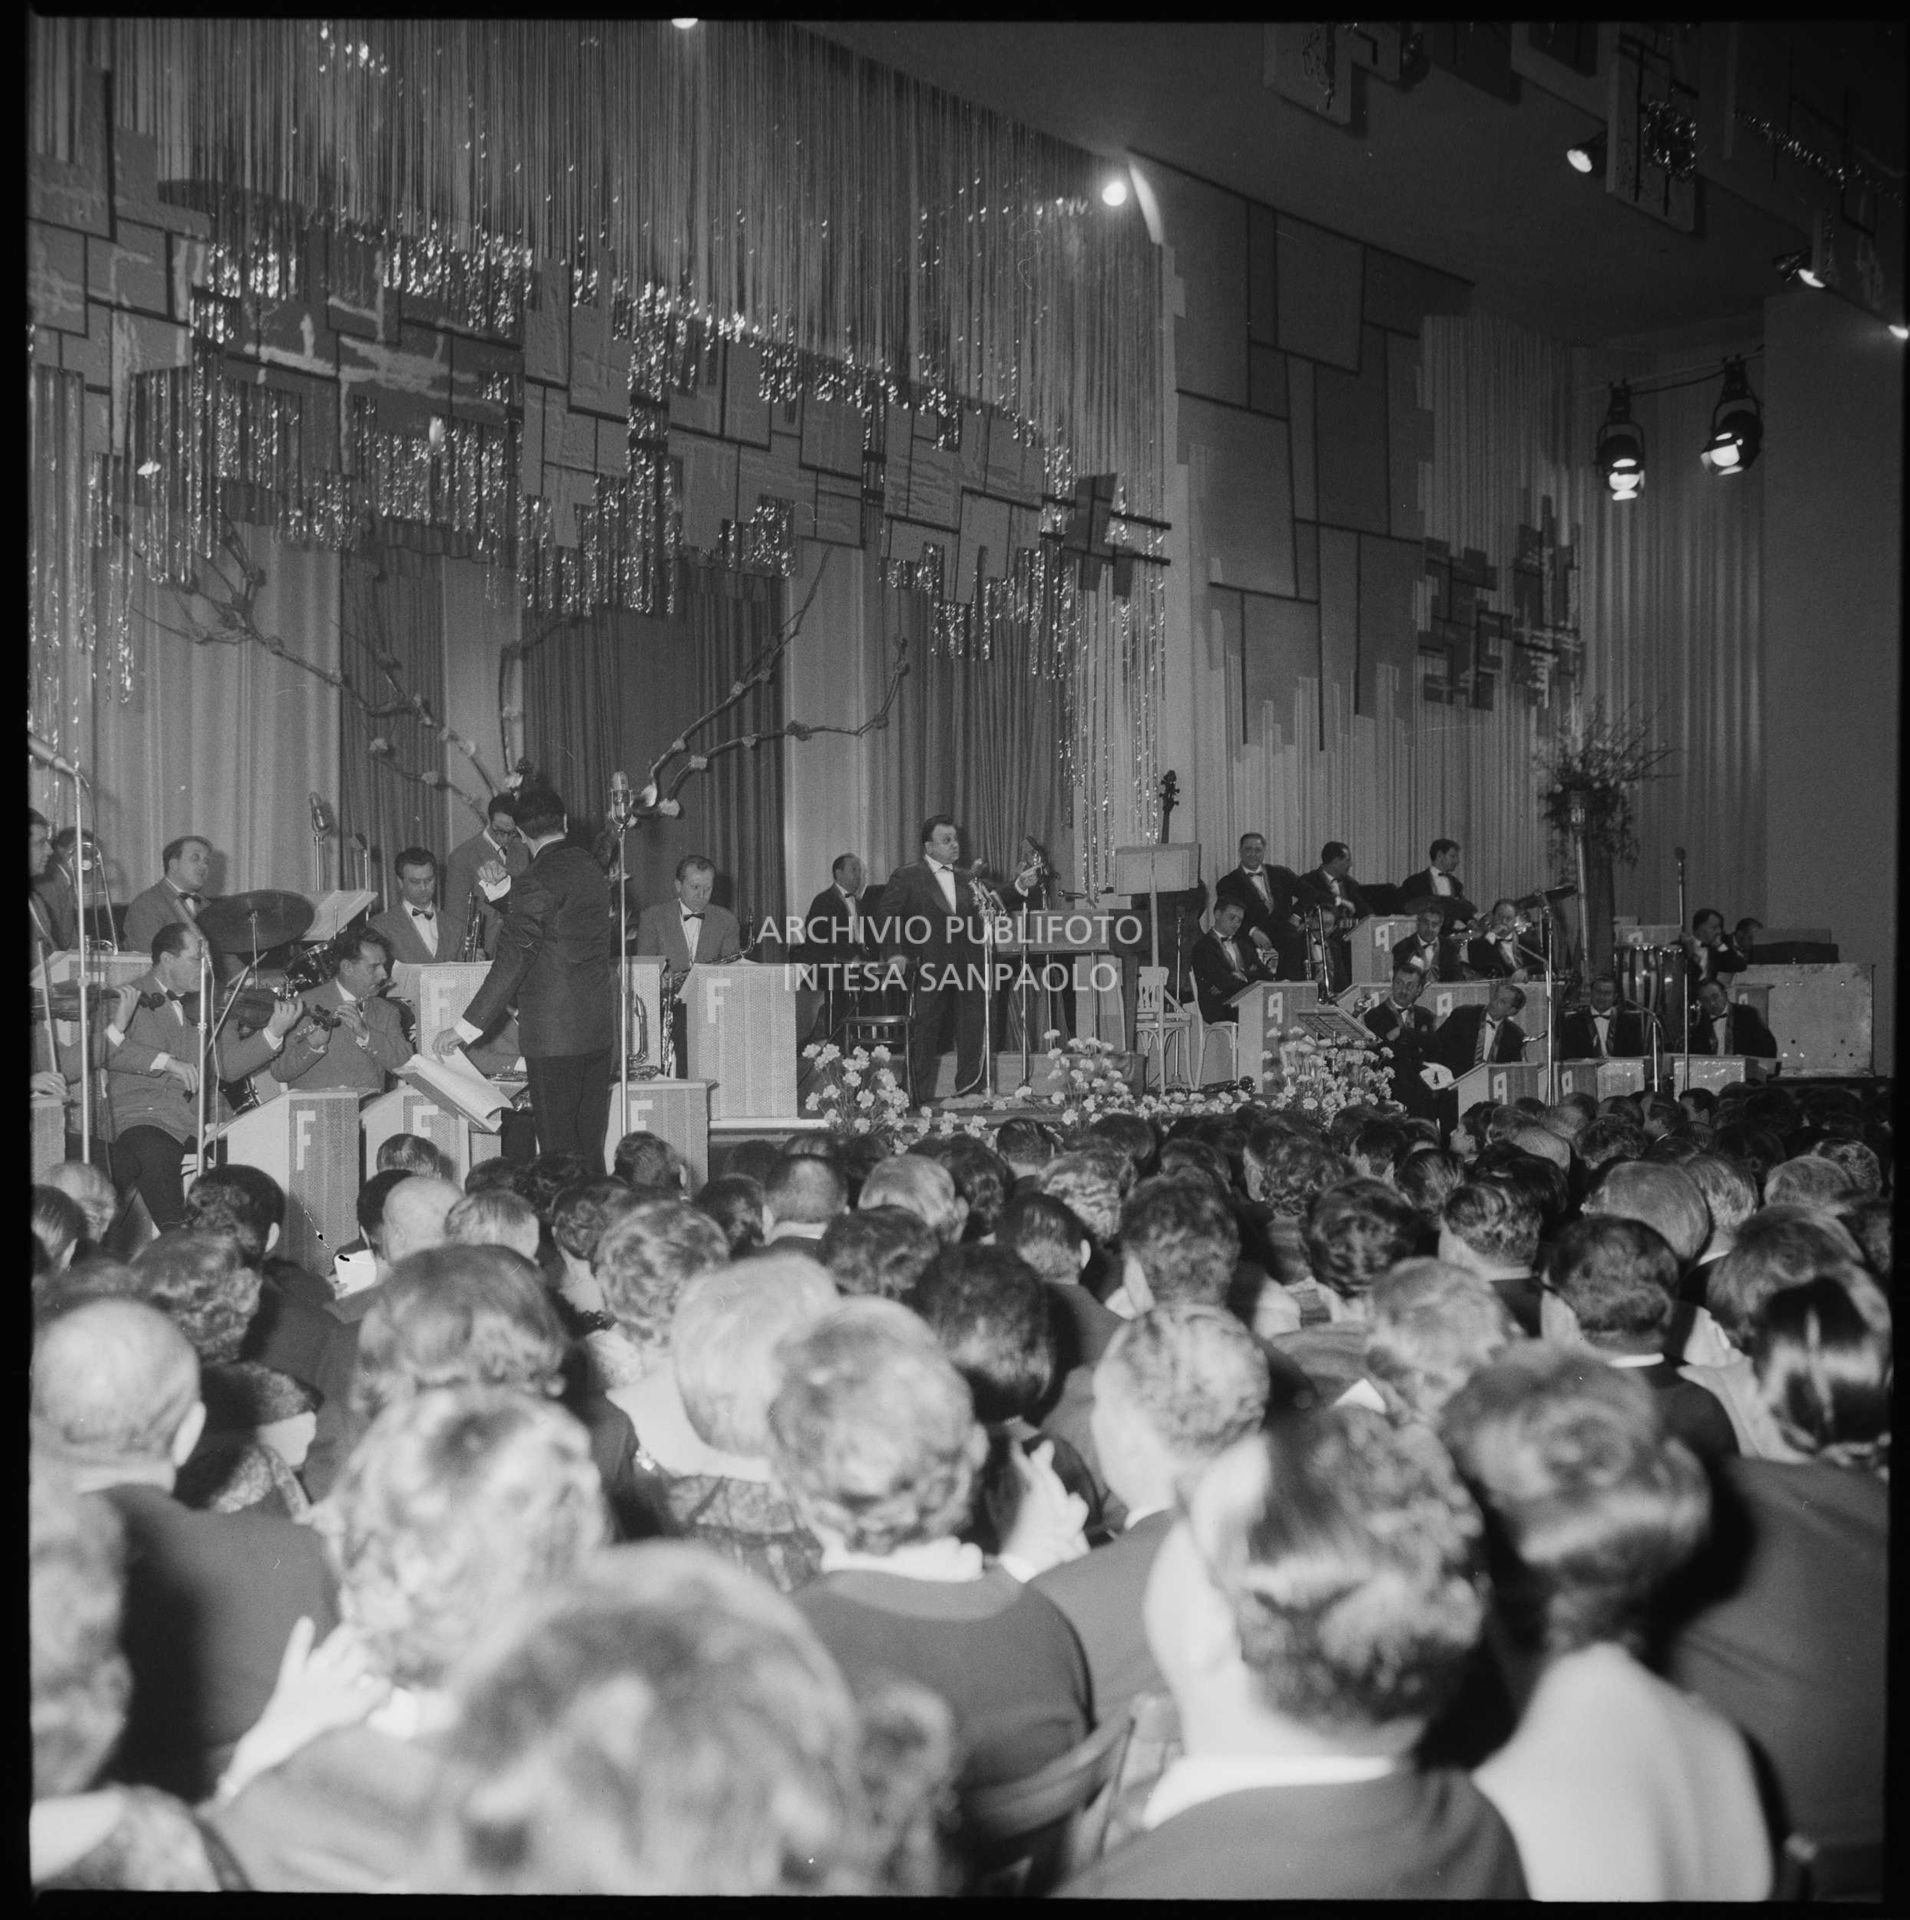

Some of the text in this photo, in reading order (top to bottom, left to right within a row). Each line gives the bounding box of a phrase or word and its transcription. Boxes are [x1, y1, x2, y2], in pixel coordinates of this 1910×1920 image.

[430, 978, 457, 1027] F
[706, 978, 731, 1024] F
[412, 1105, 438, 1138] F
[630, 1100, 653, 1132] F
[296, 1110, 316, 1171] F
